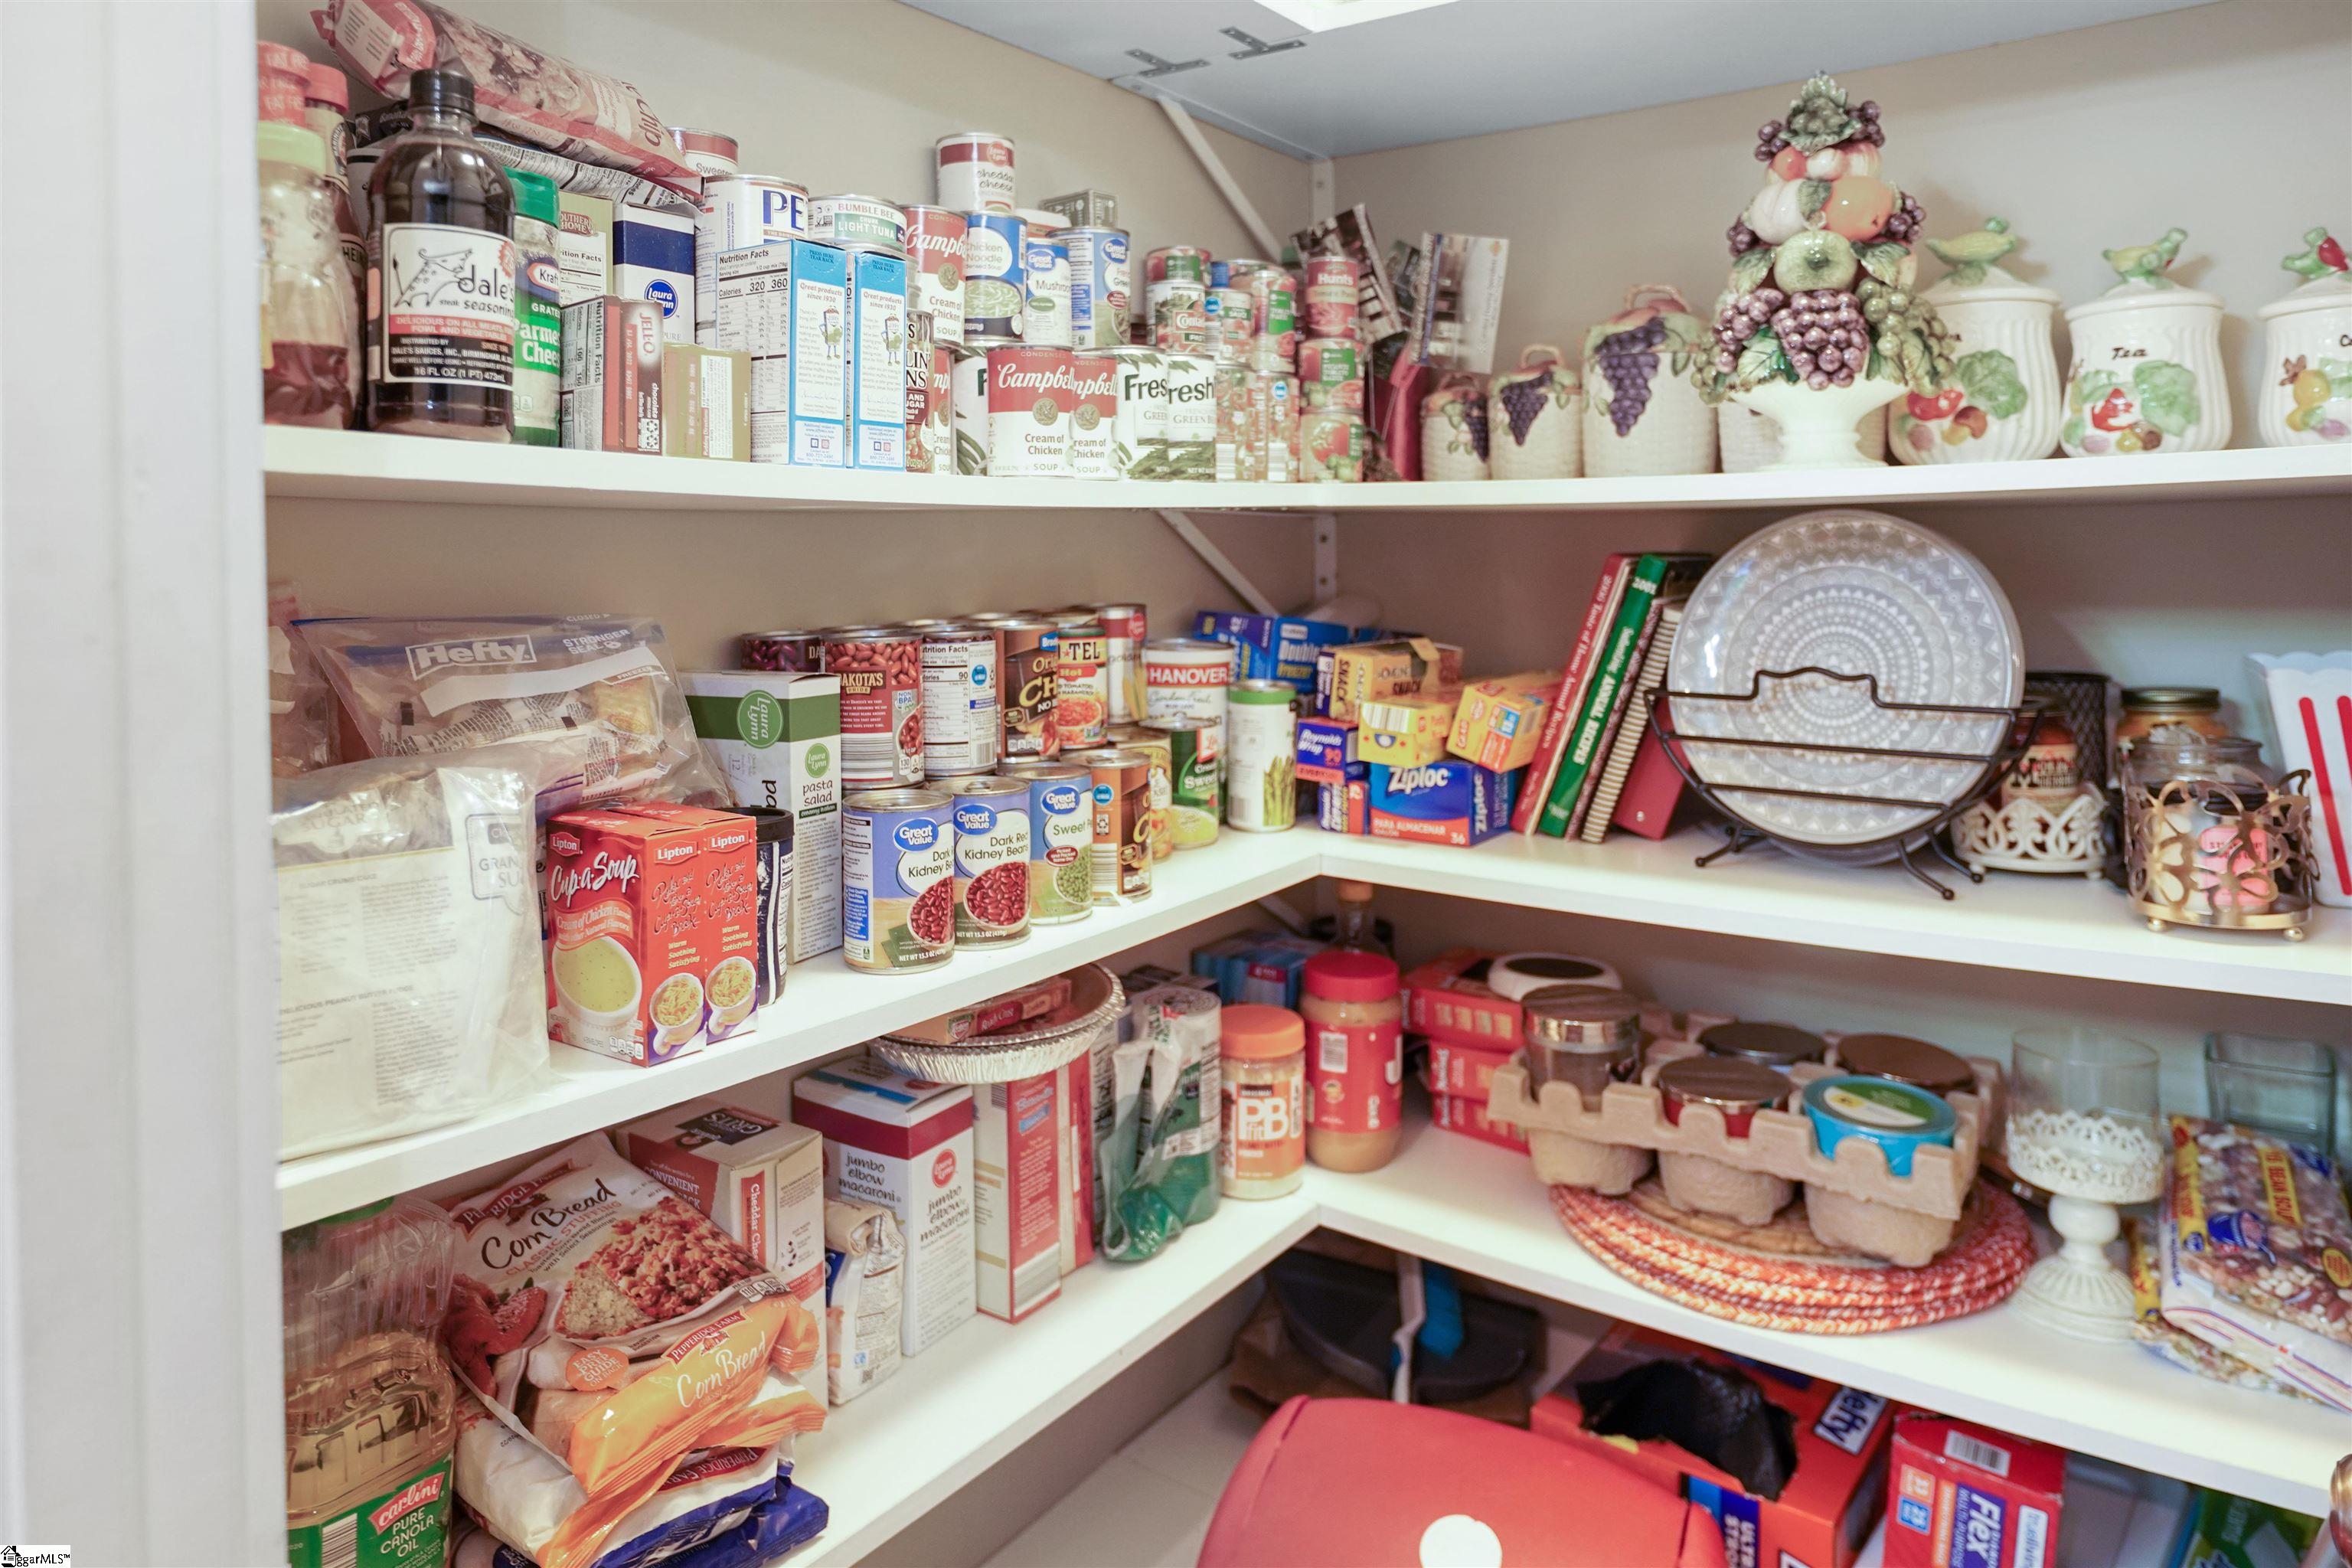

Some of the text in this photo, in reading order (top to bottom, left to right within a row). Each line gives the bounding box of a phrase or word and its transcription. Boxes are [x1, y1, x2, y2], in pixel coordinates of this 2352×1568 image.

[763, 189, 805, 231] PE
[838, 202, 894, 220] BUMBLE BEE
[838, 220, 895, 240] LIGHT TUNA
[581, 253, 602, 262] Facts
[719, 249, 769, 265] Nutrition Facts
[648, 287, 673, 302] Laura
[719, 278, 788, 298] Calories 320 360
[800, 283, 843, 297] Great products
[807, 293, 836, 303] since 1930
[864, 292, 903, 305] Great products
[929, 296, 956, 307] Cream
[397, 317, 445, 325] DELICIOUS
[440, 326, 460, 335] AND
[936, 326, 957, 336] SOUP
[594, 301, 603, 384] Nutrition Facts
[2111, 346, 2149, 361] Tea
[413, 368, 426, 377] 16
[426, 368, 440, 377] FL
[441, 368, 457, 377] OZ
[1125, 374, 1168, 401] Fres
[1168, 376, 1214, 404] resh
[1024, 433, 1055, 443] Cream
[1027, 446, 1063, 455] Chicken
[567, 613, 600, 622] CLOSED
[563, 629, 630, 647] STRONGER
[414, 640, 527, 668] Hefty
[569, 642, 603, 655] SEAL
[617, 665, 652, 680] FREEZER
[841, 672, 884, 688] AKOTA'S
[1149, 668, 1227, 684] HANOVER
[1037, 701, 1051, 713] NO
[747, 706, 760, 740] Lynn
[757, 697, 770, 739] Laura
[1302, 730, 1342, 746] Reynolds
[1298, 739, 1323, 756] Wrap
[808, 753, 826, 763] Laura
[812, 759, 827, 771] Lynn
[802, 779, 833, 796] pasta
[1388, 766, 1449, 795] Ziploc
[804, 791, 832, 807] salad
[1046, 791, 1076, 805] Great
[1054, 802, 1076, 810] Value
[1475, 772, 1488, 835] Ziploc
[957, 811, 989, 825] Great
[964, 822, 990, 830] Value
[900, 825, 933, 839] Great
[1053, 822, 1086, 836] Sweet
[553, 838, 577, 850] Lipton
[711, 834, 746, 848] Lipton
[908, 836, 933, 845] Value
[990, 835, 1014, 847] Dark
[658, 847, 693, 860] Lipton
[933, 849, 950, 862] Dark
[965, 848, 1004, 861] Kidney
[908, 863, 943, 878] Kidney
[722, 925, 740, 934] Warm
[722, 931, 749, 943] Soothing
[668, 940, 688, 949] Warm
[722, 939, 753, 952] Satisfying
[668, 948, 696, 959] Soothing
[668, 956, 701, 969] Satisfying
[1238, 1097, 1289, 1141] PB
[846, 1152, 885, 1173] jumbo
[848, 1168, 885, 1186] elbow
[838, 1178, 895, 1202] macaroni
[750, 1184, 760, 1231] Cheddar
[927, 1186, 962, 1214] jumbo
[929, 1203, 960, 1224] elbow
[481, 1178, 616, 1269] Corn Bread
[920, 1206, 970, 1242] macaroni
[505, 1200, 622, 1276] CLASSIC STUFFING
[671, 1315, 740, 1358] PEPPERIDGE FARM
[573, 1350, 603, 1368] EASY
[579, 1354, 609, 1375] PREP
[583, 1358, 619, 1383] GUIDE
[590, 1364, 624, 1387] ON BACK
[677, 1331, 766, 1408] Corn Bread
[378, 1478, 439, 1527] carlini
[392, 1507, 426, 1535] PURE
[380, 1514, 435, 1555] CANOLA
[397, 1541, 420, 1557] OIL
